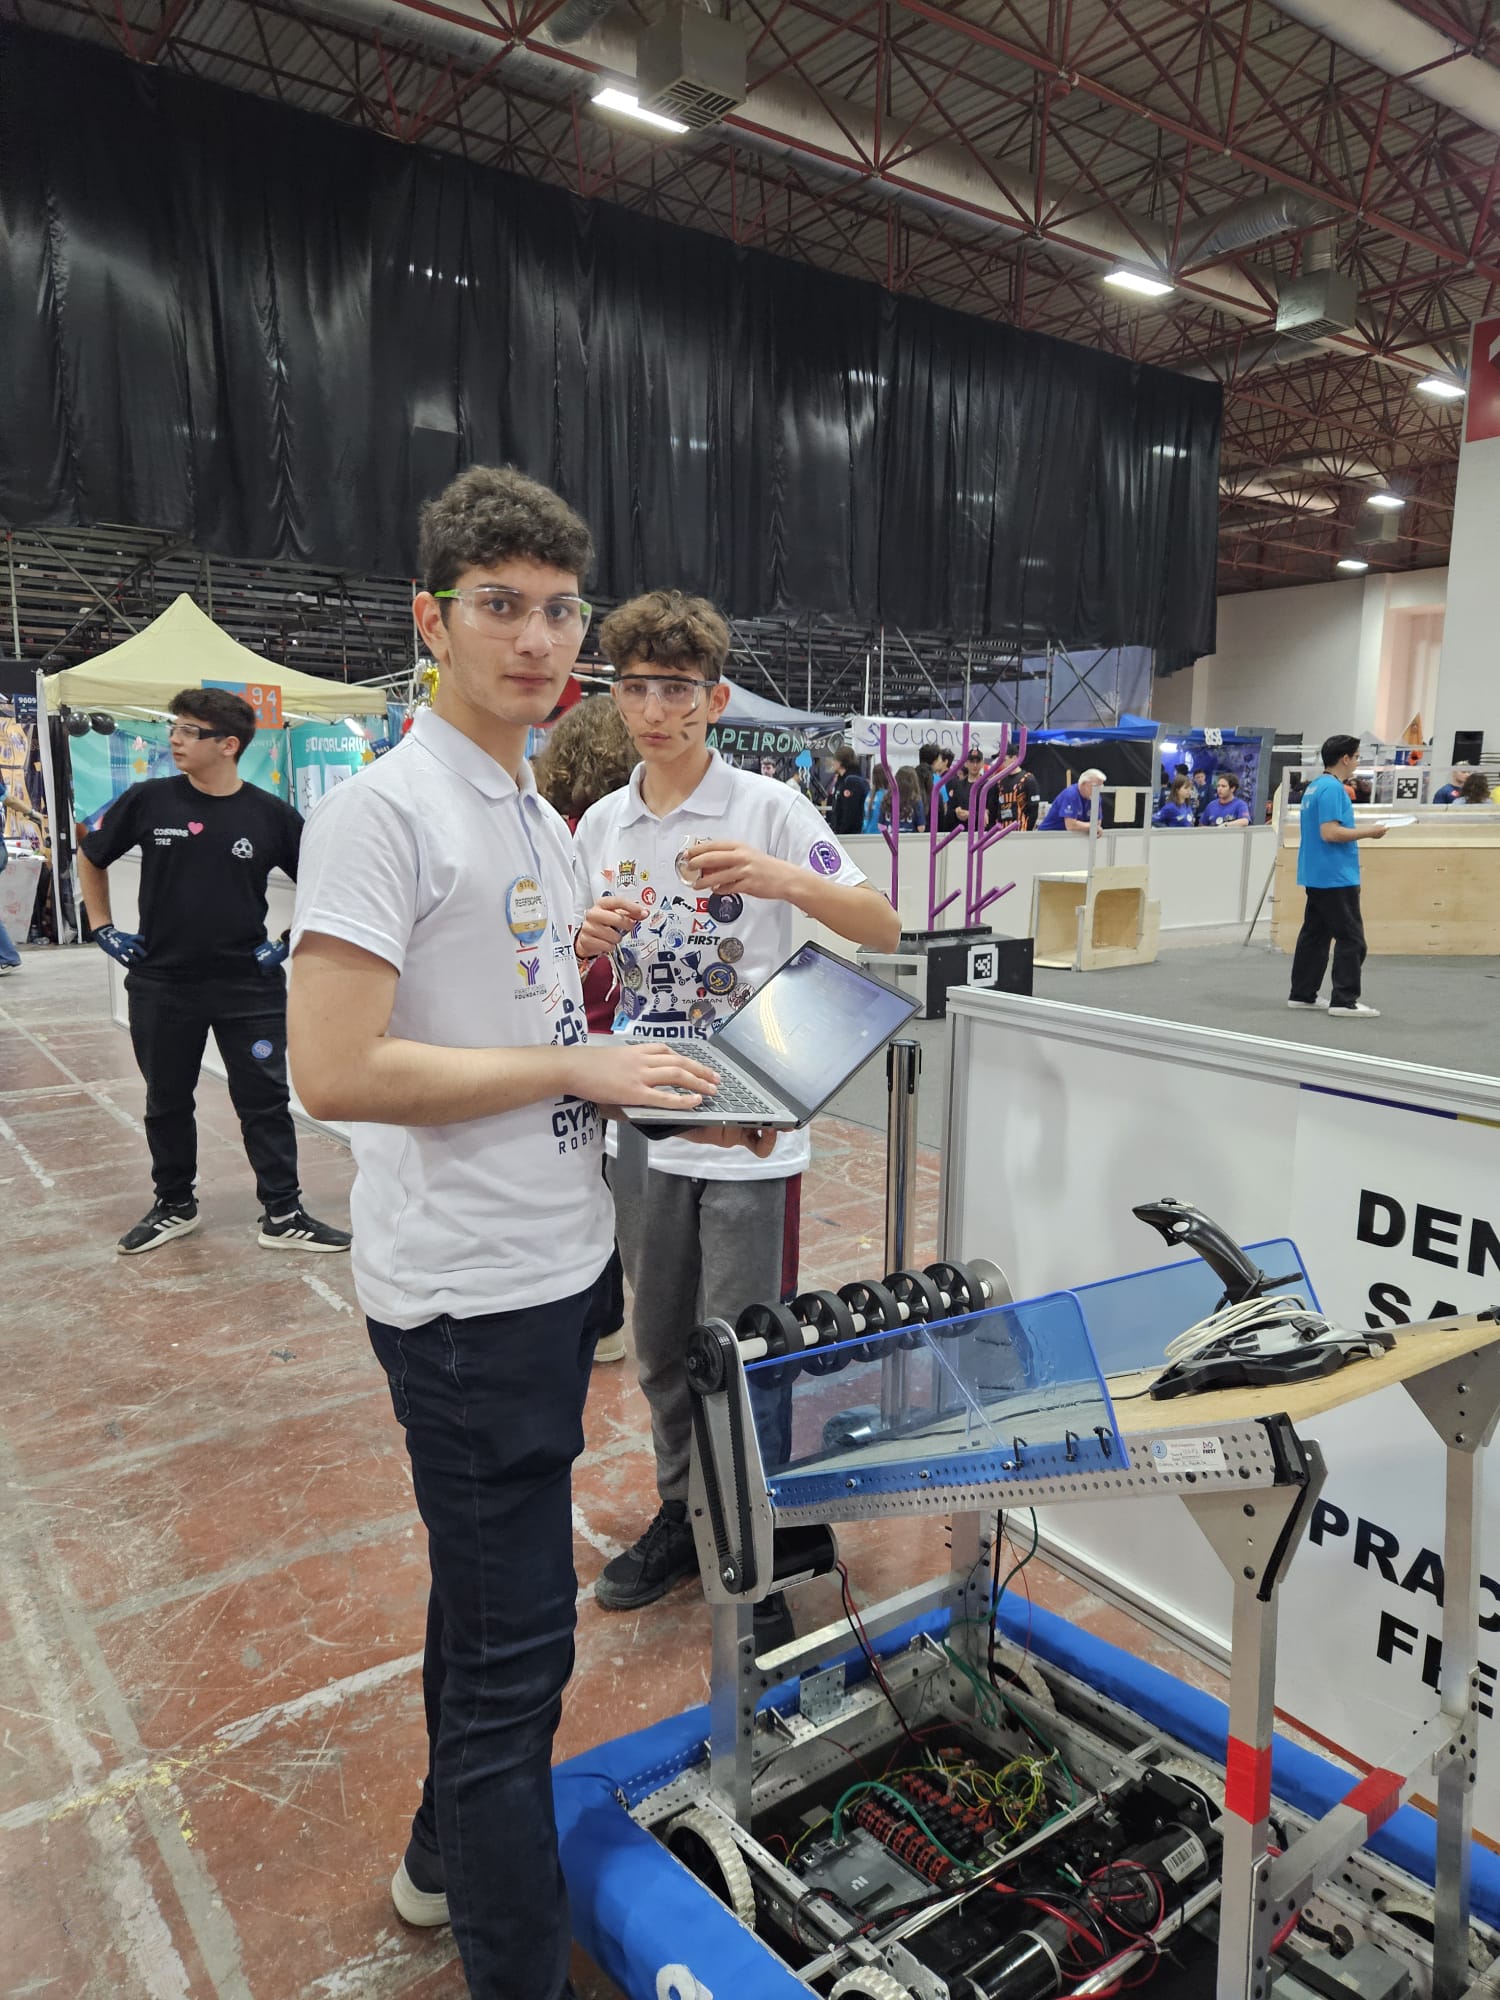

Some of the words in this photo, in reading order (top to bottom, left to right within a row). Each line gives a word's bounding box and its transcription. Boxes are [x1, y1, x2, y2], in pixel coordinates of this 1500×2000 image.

[251, 687, 277, 706] 94
[704, 727, 805, 753] APEIRON
[687, 935, 721, 946] FIRST
